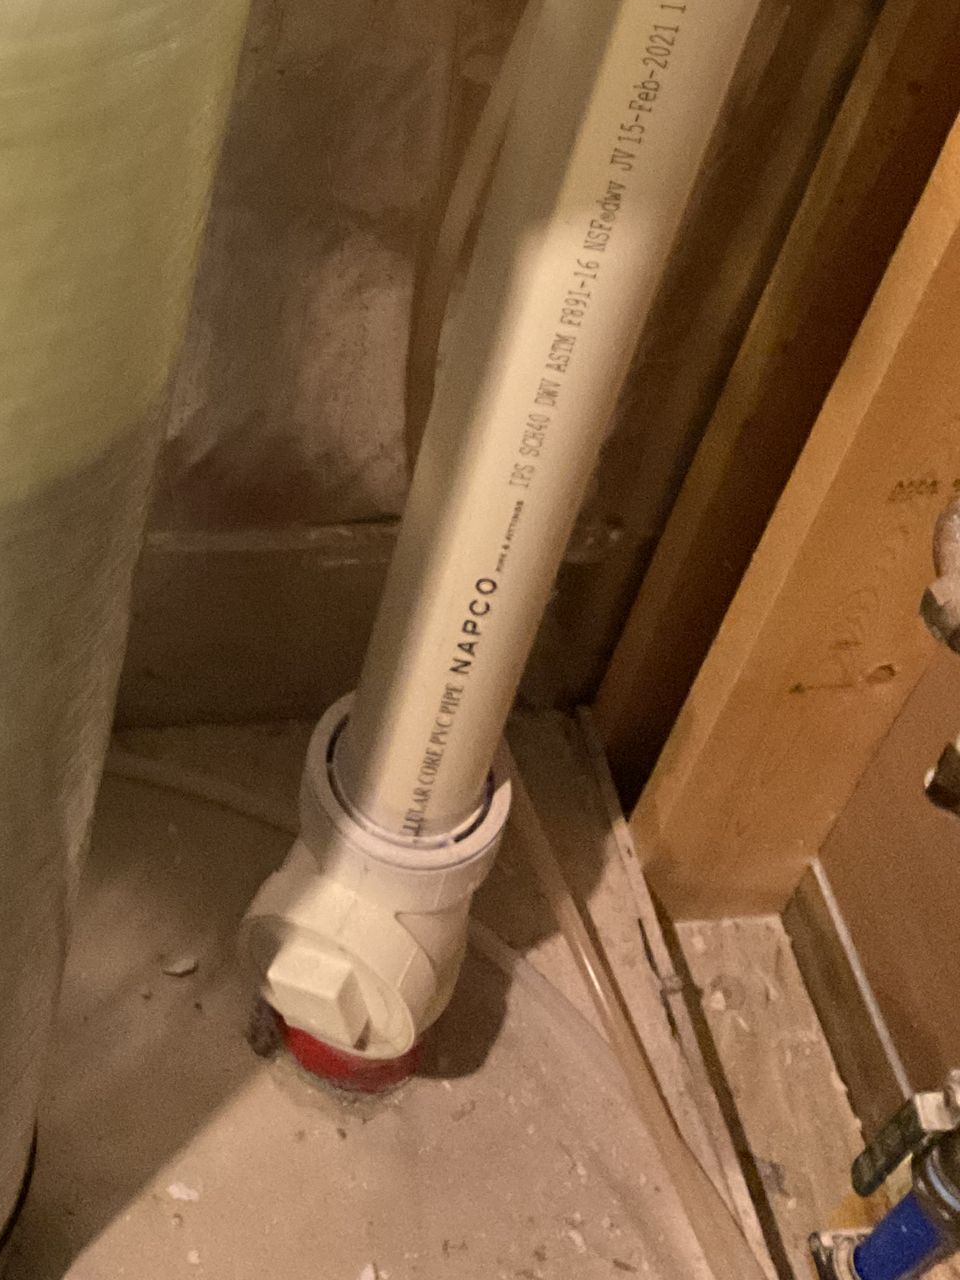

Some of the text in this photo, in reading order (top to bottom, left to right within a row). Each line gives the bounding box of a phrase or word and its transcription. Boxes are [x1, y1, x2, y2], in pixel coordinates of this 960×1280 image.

[617, 22, 681, 145] 15-Feb-2021
[559, 257, 600, 329] F891-16
[545, 332, 577, 374] ASTM
[534, 377, 562, 408] DWV
[518, 412, 551, 458] SCH40
[449, 577, 498, 675] NAPCO
[440, 681, 465, 717] PIPE
[430, 715, 454, 748] PVC
[418, 747, 445, 787] CORE
